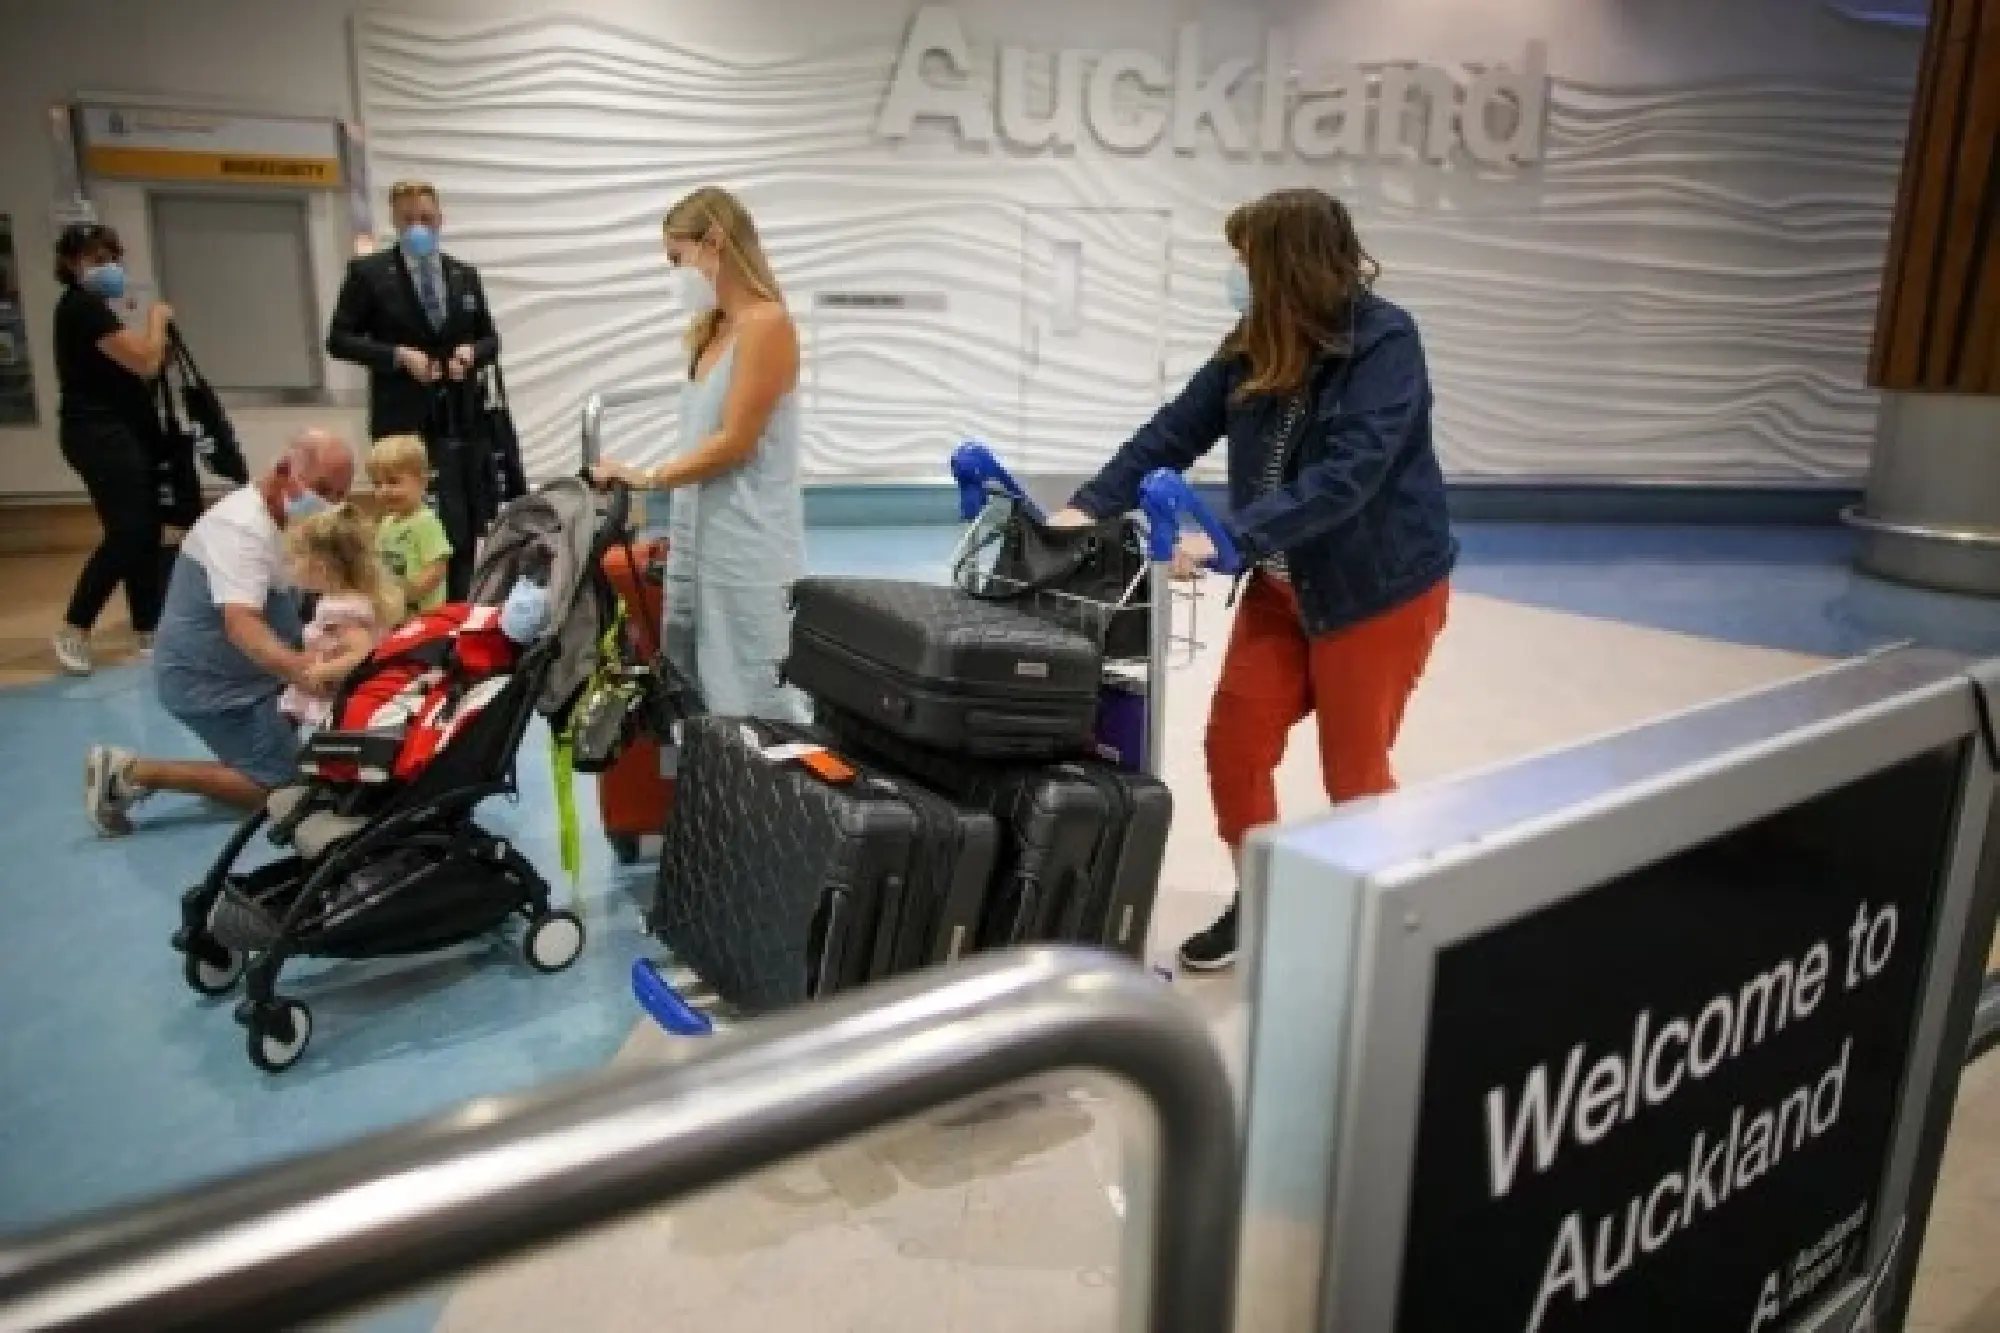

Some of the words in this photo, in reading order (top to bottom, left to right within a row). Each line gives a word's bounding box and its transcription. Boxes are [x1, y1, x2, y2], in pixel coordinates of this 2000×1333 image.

[874, 3, 1550, 168] Auckland
[1486, 938, 1829, 1197] Welcome
[1846, 899, 1898, 988] to
[1526, 1036, 1853, 1333] Auckland
